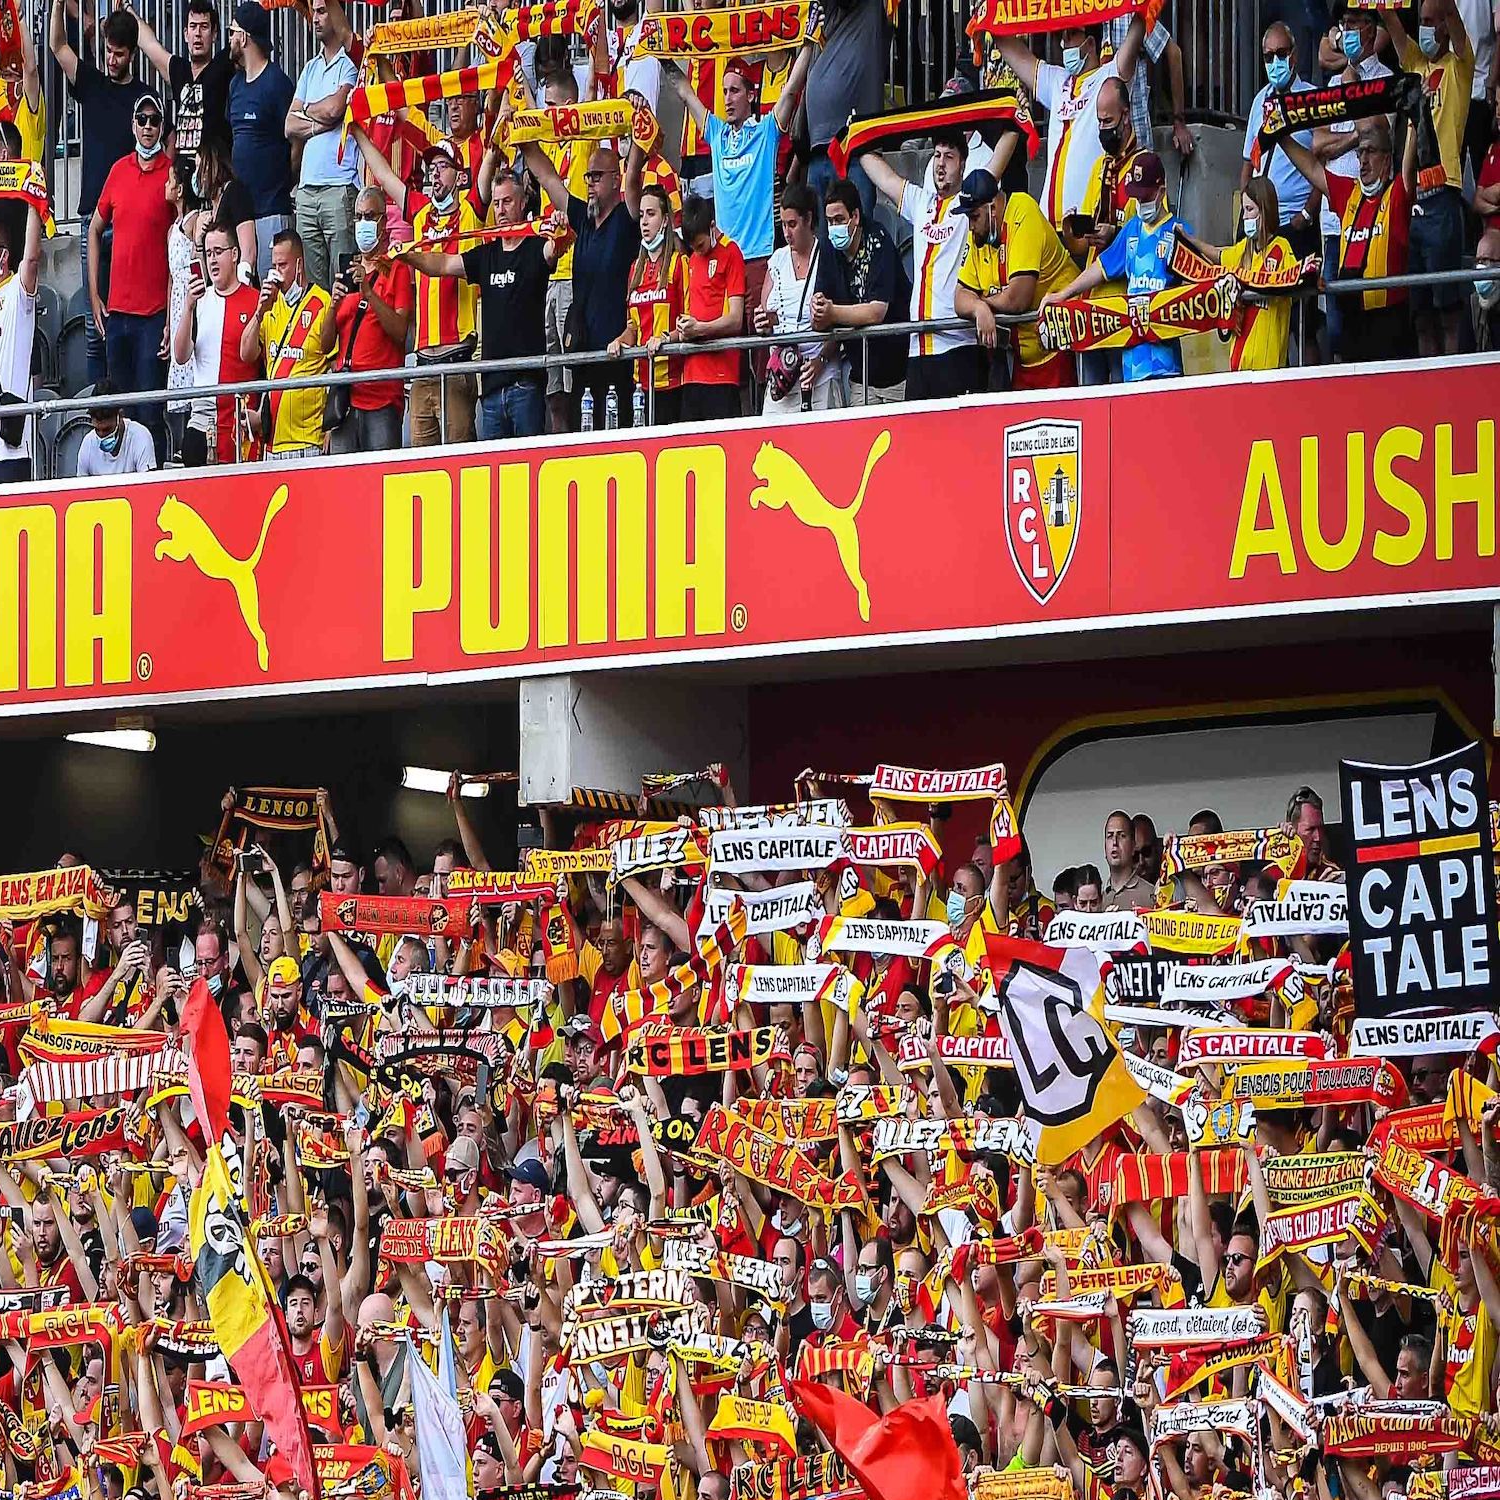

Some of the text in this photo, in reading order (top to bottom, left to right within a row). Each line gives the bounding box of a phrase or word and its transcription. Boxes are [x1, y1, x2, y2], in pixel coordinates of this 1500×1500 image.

[994, 2, 1045, 24] ALLEZ
[731, 6, 801, 46] LENS
[1284, 81, 1386, 111] RACING CLUB
[1290, 102, 1346, 125] DE LENS
[630, 288, 667, 306] Auchan
[1047, 287, 1232, 347] FIER LENSOIS
[1010, 439, 1033, 452] RACING
[1035, 439, 1050, 451] CLUB
[1062, 437, 1075, 449] LENS
[383, 445, 725, 661] PUMA
[872, 766, 998, 792] LENS CAPITALE
[1350, 768, 1478, 841] LENS
[713, 838, 837, 863] LENS CAPITALE
[1359, 854, 1486, 929] CAPI
[751, 895, 814, 922] CAPITALE
[846, 923, 929, 944] LENS CAPITALE
[1043, 921, 1144, 943] ENS CAPITALE
[1179, 917, 1203, 939] CLUB
[1205, 922, 1218, 940] DE
[1220, 923, 1241, 941] LEN
[1362, 924, 1490, 997] TALE
[755, 975, 816, 993] LENS CAPITALE
[1173, 971, 1207, 990] LENS
[1210, 965, 1271, 990] CAPITALE
[27, 1028, 101, 1055] LENSOIS POUR
[1206, 1035, 1306, 1056] CAPITALE
[1355, 1019, 1483, 1048] LENS CAPITALE
[687, 1029, 772, 1066] LENS
[942, 1035, 1013, 1059] CAPITAL
[1235, 1066, 1373, 1096] LENSOIS POUR TOUJOURS
[0, 1106, 126, 1156] Allez Lens
[1268, 1164, 1328, 1189] RACING CLUB
[382, 1220, 424, 1238] RACING
[1295, 1216, 1320, 1241] CLUB
[381, 1239, 424, 1257] CLUB DE
[44, 1312, 95, 1339] RCL
[188, 1387, 245, 1420] LENS
[1374, 1440, 1427, 1454] DEPUIS 1906
[612, 1445, 655, 1478] RCL
